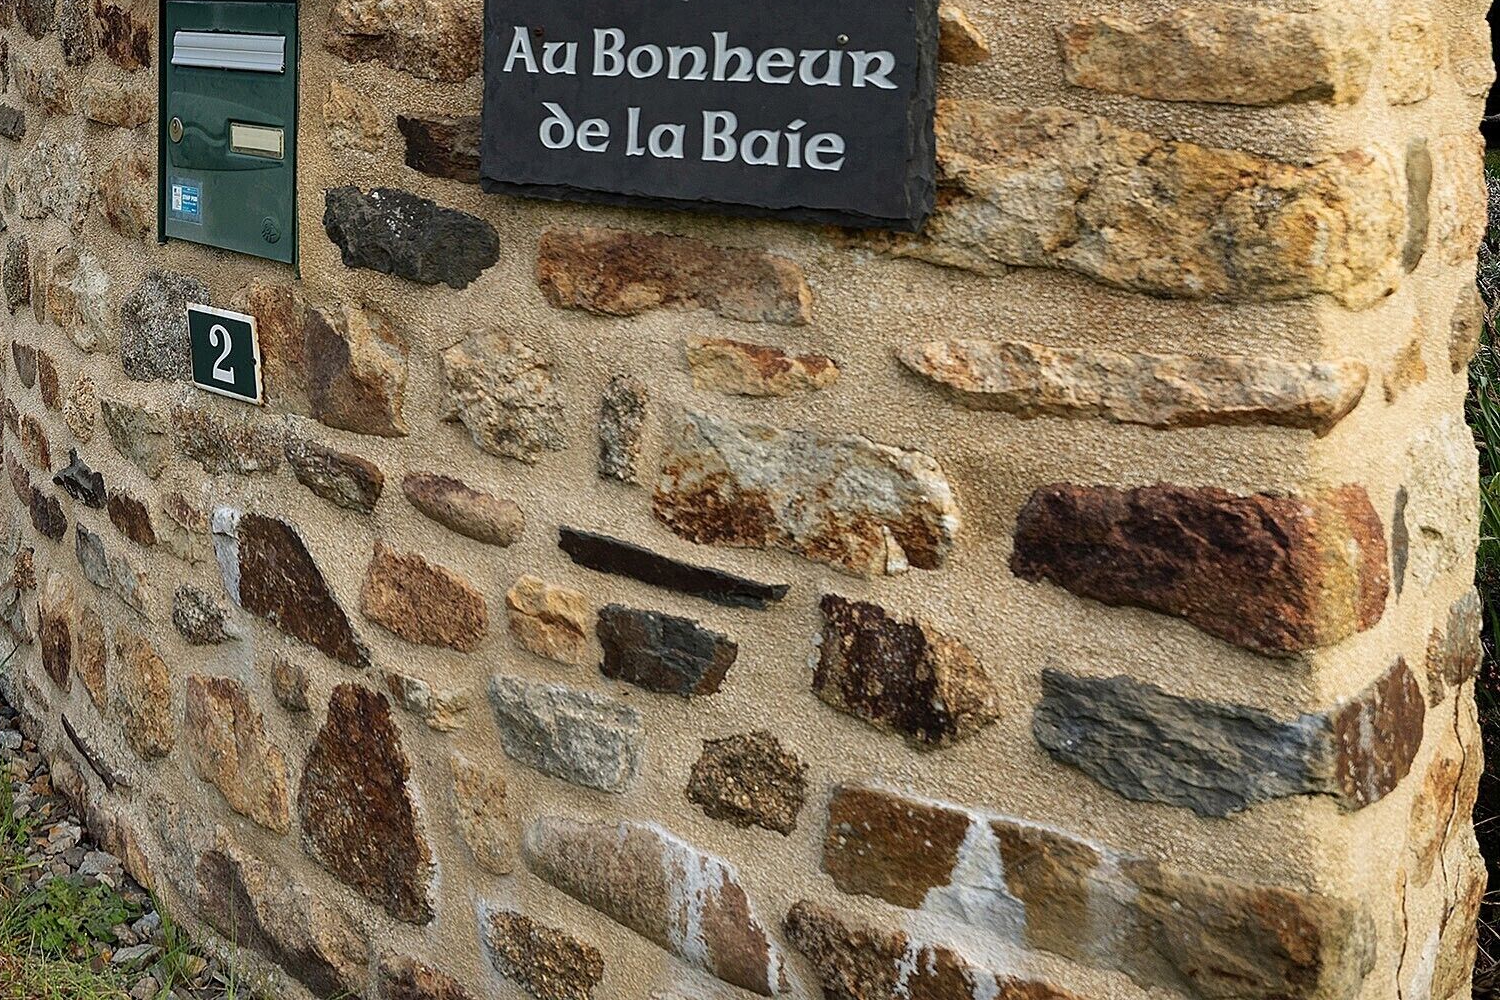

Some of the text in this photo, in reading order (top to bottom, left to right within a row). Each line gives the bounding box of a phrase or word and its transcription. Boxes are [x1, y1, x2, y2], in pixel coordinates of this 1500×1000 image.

[502, 25, 899, 90] Au Bonheur
[538, 101, 611, 153] de
[700, 109, 847, 171] Baie
[208, 323, 236, 385] 2
